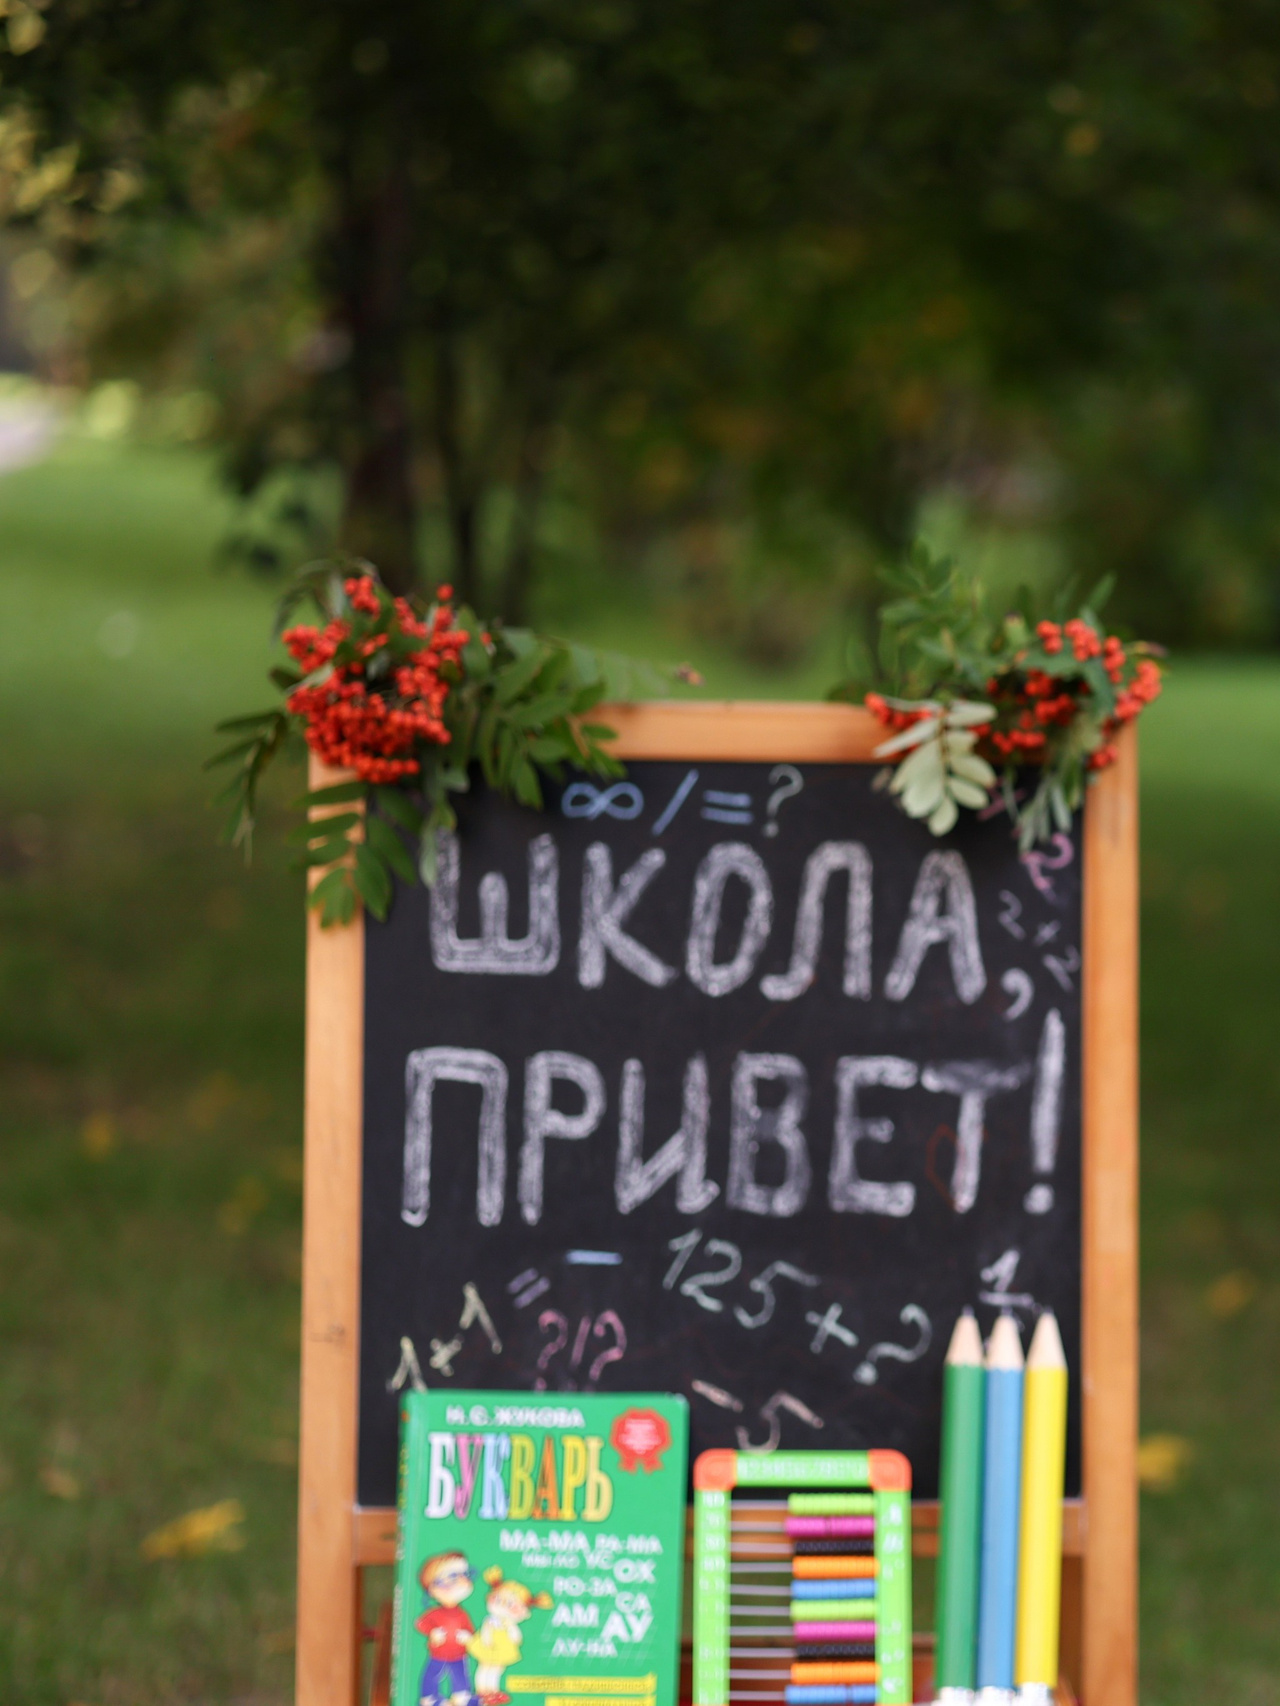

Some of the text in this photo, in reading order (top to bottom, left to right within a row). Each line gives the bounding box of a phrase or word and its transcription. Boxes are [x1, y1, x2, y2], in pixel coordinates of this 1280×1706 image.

[429, 830, 1033, 1019] ШКОЛА,
[401, 1007, 1066, 1227] ПРИВЕТ!
[424, 1431, 614, 1523] БУКВАРЬ
[613, 1557, 657, 1584] ОХ
[551, 1602, 599, 1628] АМ
[600, 1610, 654, 1644] АУ
